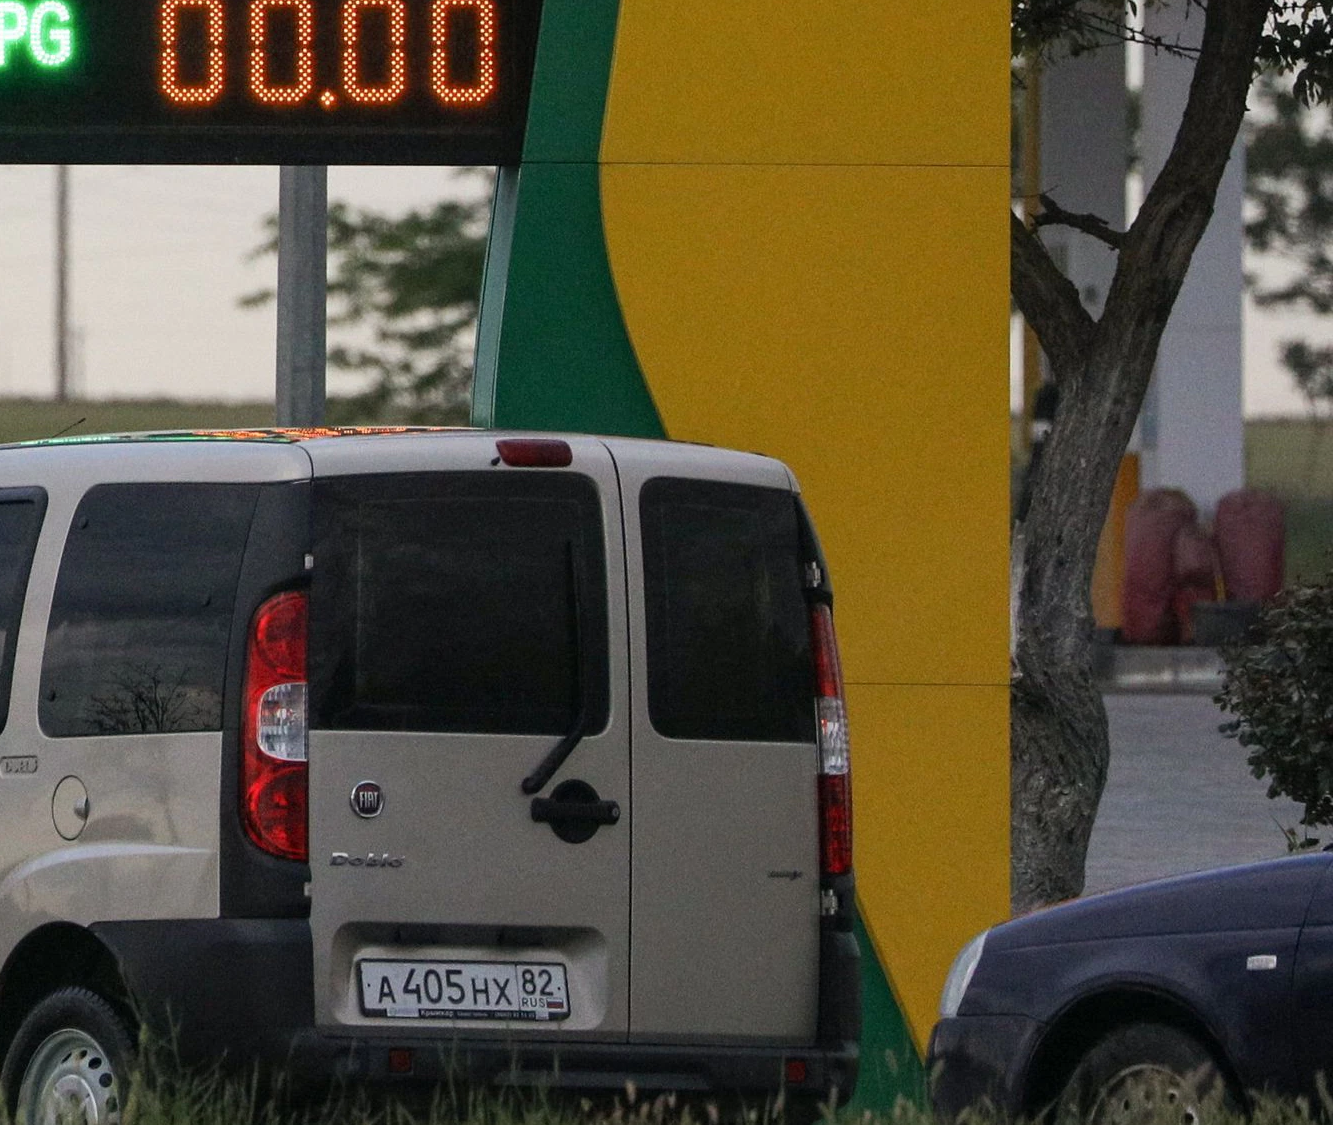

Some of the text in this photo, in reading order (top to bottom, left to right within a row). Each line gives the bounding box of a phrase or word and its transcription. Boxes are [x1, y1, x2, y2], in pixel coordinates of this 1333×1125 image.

[359, 791, 379, 809] FIAT
[520, 968, 554, 996] 82
[520, 996, 546, 1008] RUS
